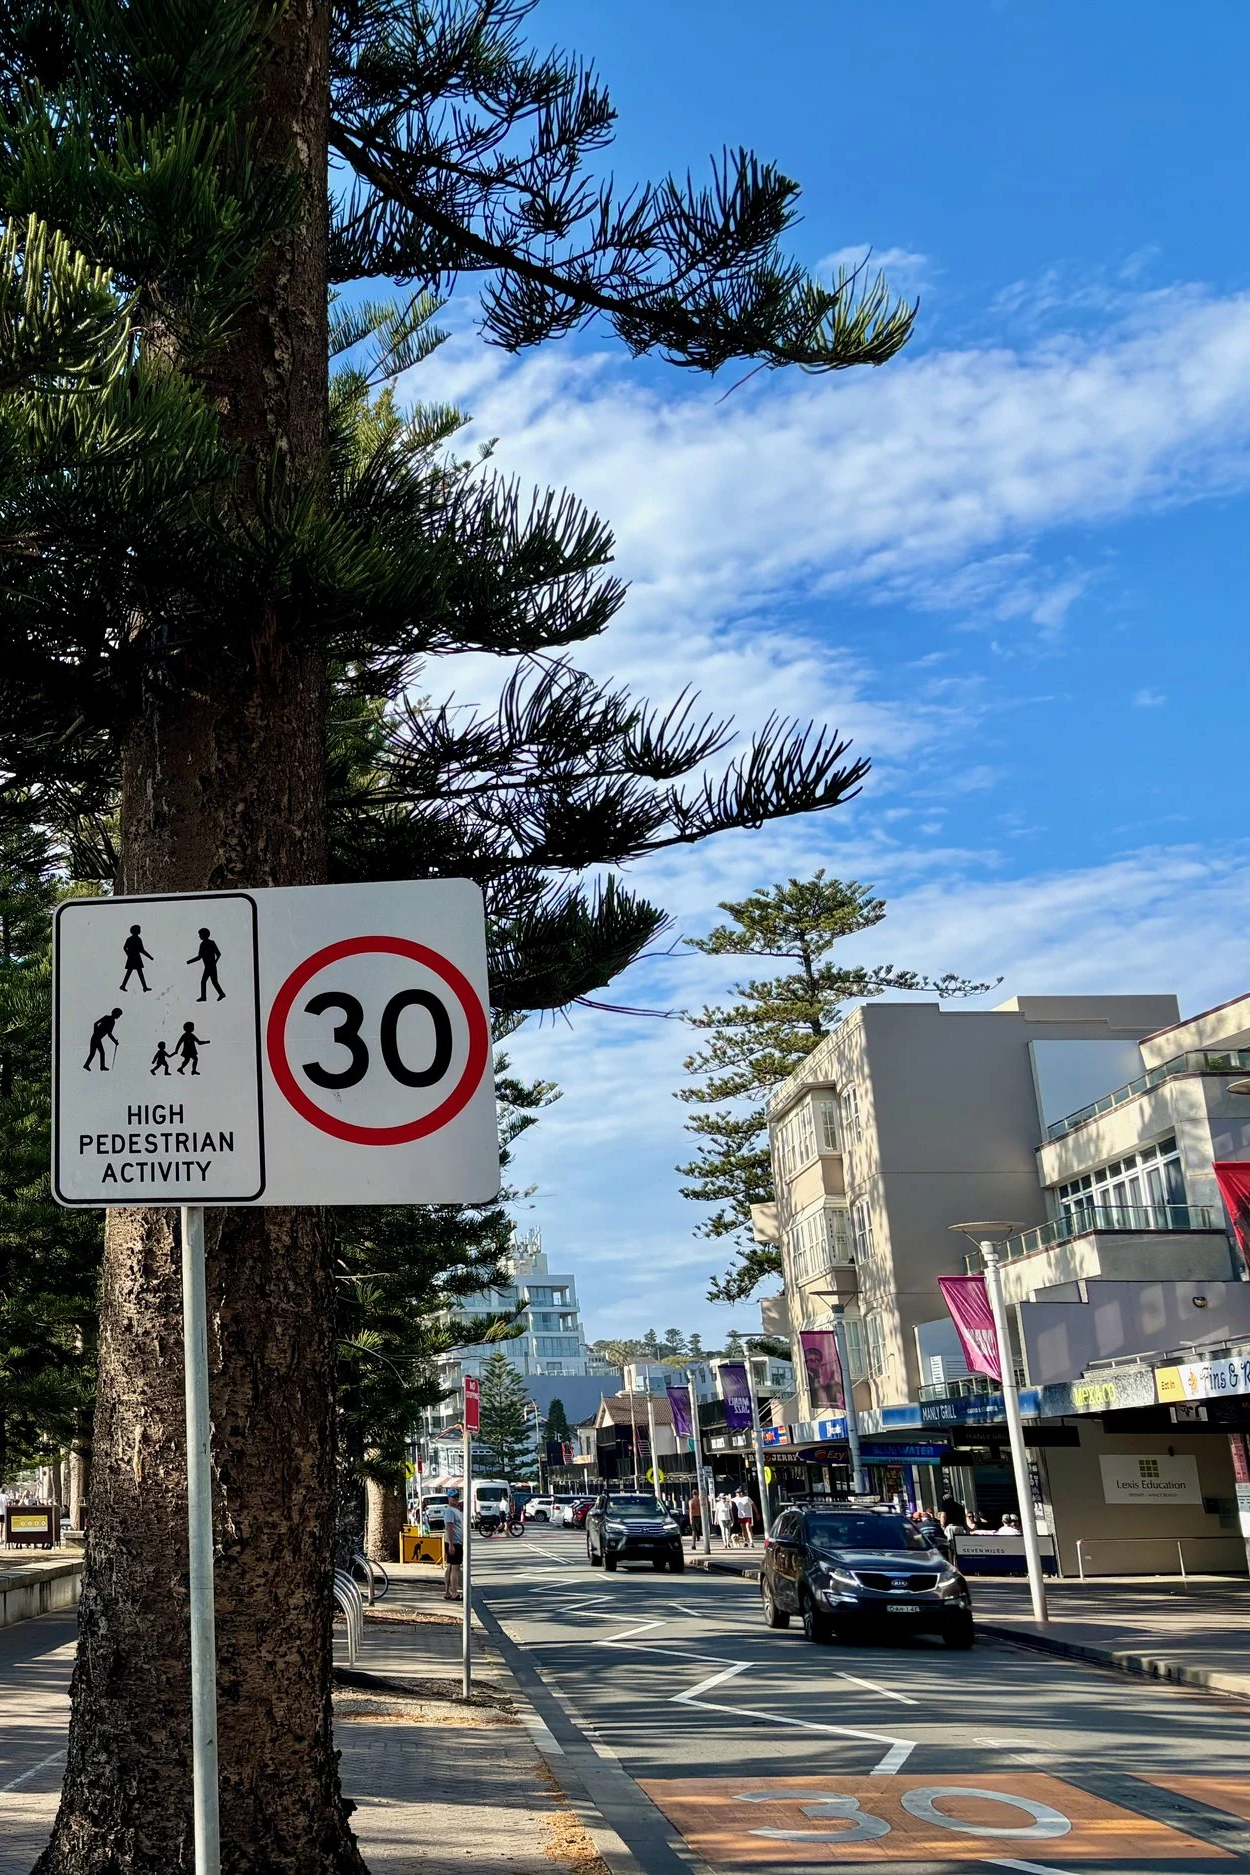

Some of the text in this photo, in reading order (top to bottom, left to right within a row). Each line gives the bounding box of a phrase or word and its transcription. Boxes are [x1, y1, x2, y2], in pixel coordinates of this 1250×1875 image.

[302, 988, 453, 1090] 30
[127, 1104, 185, 1126] HIGH
[79, 1131, 235, 1155] PEDESTRIAN
[101, 1160, 212, 1183] ACTIVITY
[1200, 1366, 1227, 1392] Fins
[1228, 1362, 1239, 1388] &
[922, 1406, 940, 1421] MANLY
[940, 1404, 957, 1419] GRILL
[827, 1450, 847, 1461] Ezy
[1116, 1479, 1187, 1490] Lexis Education
[731, 1785, 1073, 1844] 30
